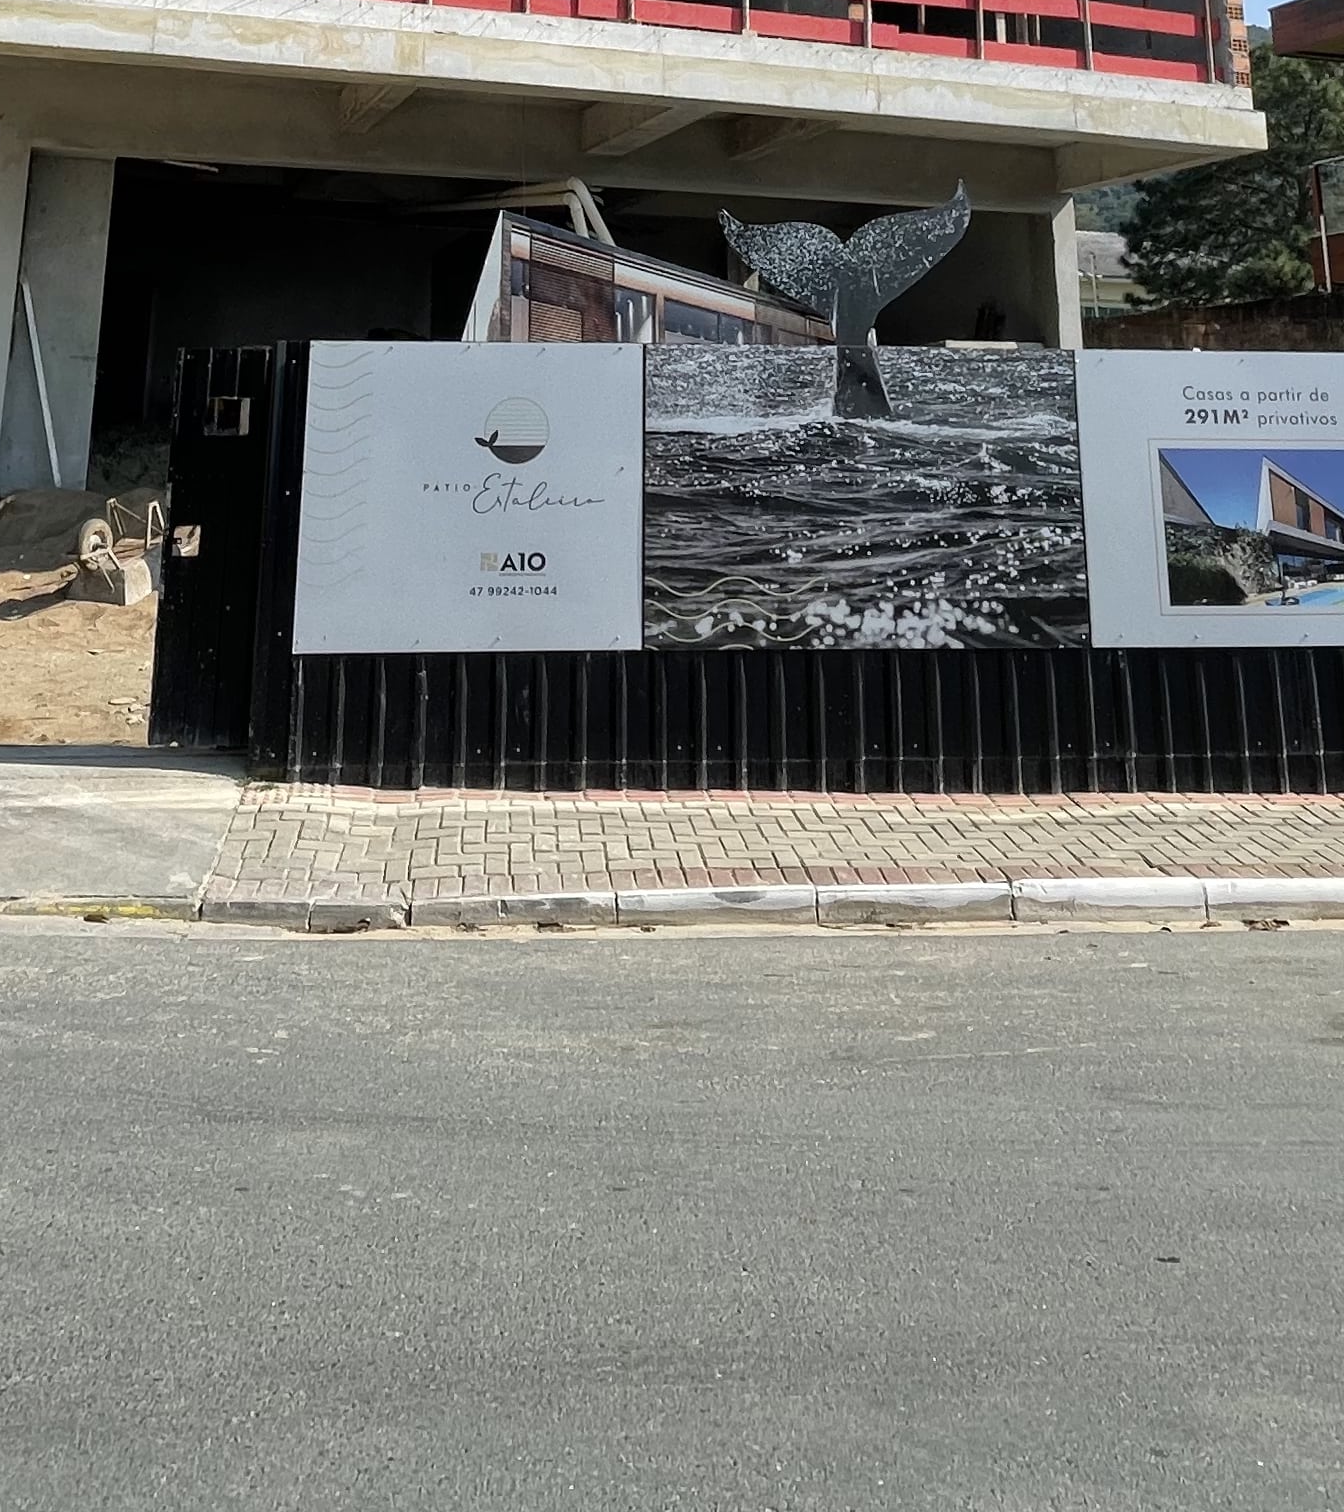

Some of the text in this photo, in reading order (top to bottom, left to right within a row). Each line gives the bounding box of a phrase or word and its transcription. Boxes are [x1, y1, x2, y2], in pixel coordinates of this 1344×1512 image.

[1182, 385, 1329, 404] Casas a partir de
[1258, 410, 1338, 428] privativos
[472, 472, 605, 514] Estaleiro
[469, 586, 557, 597] 47 99242-1044
